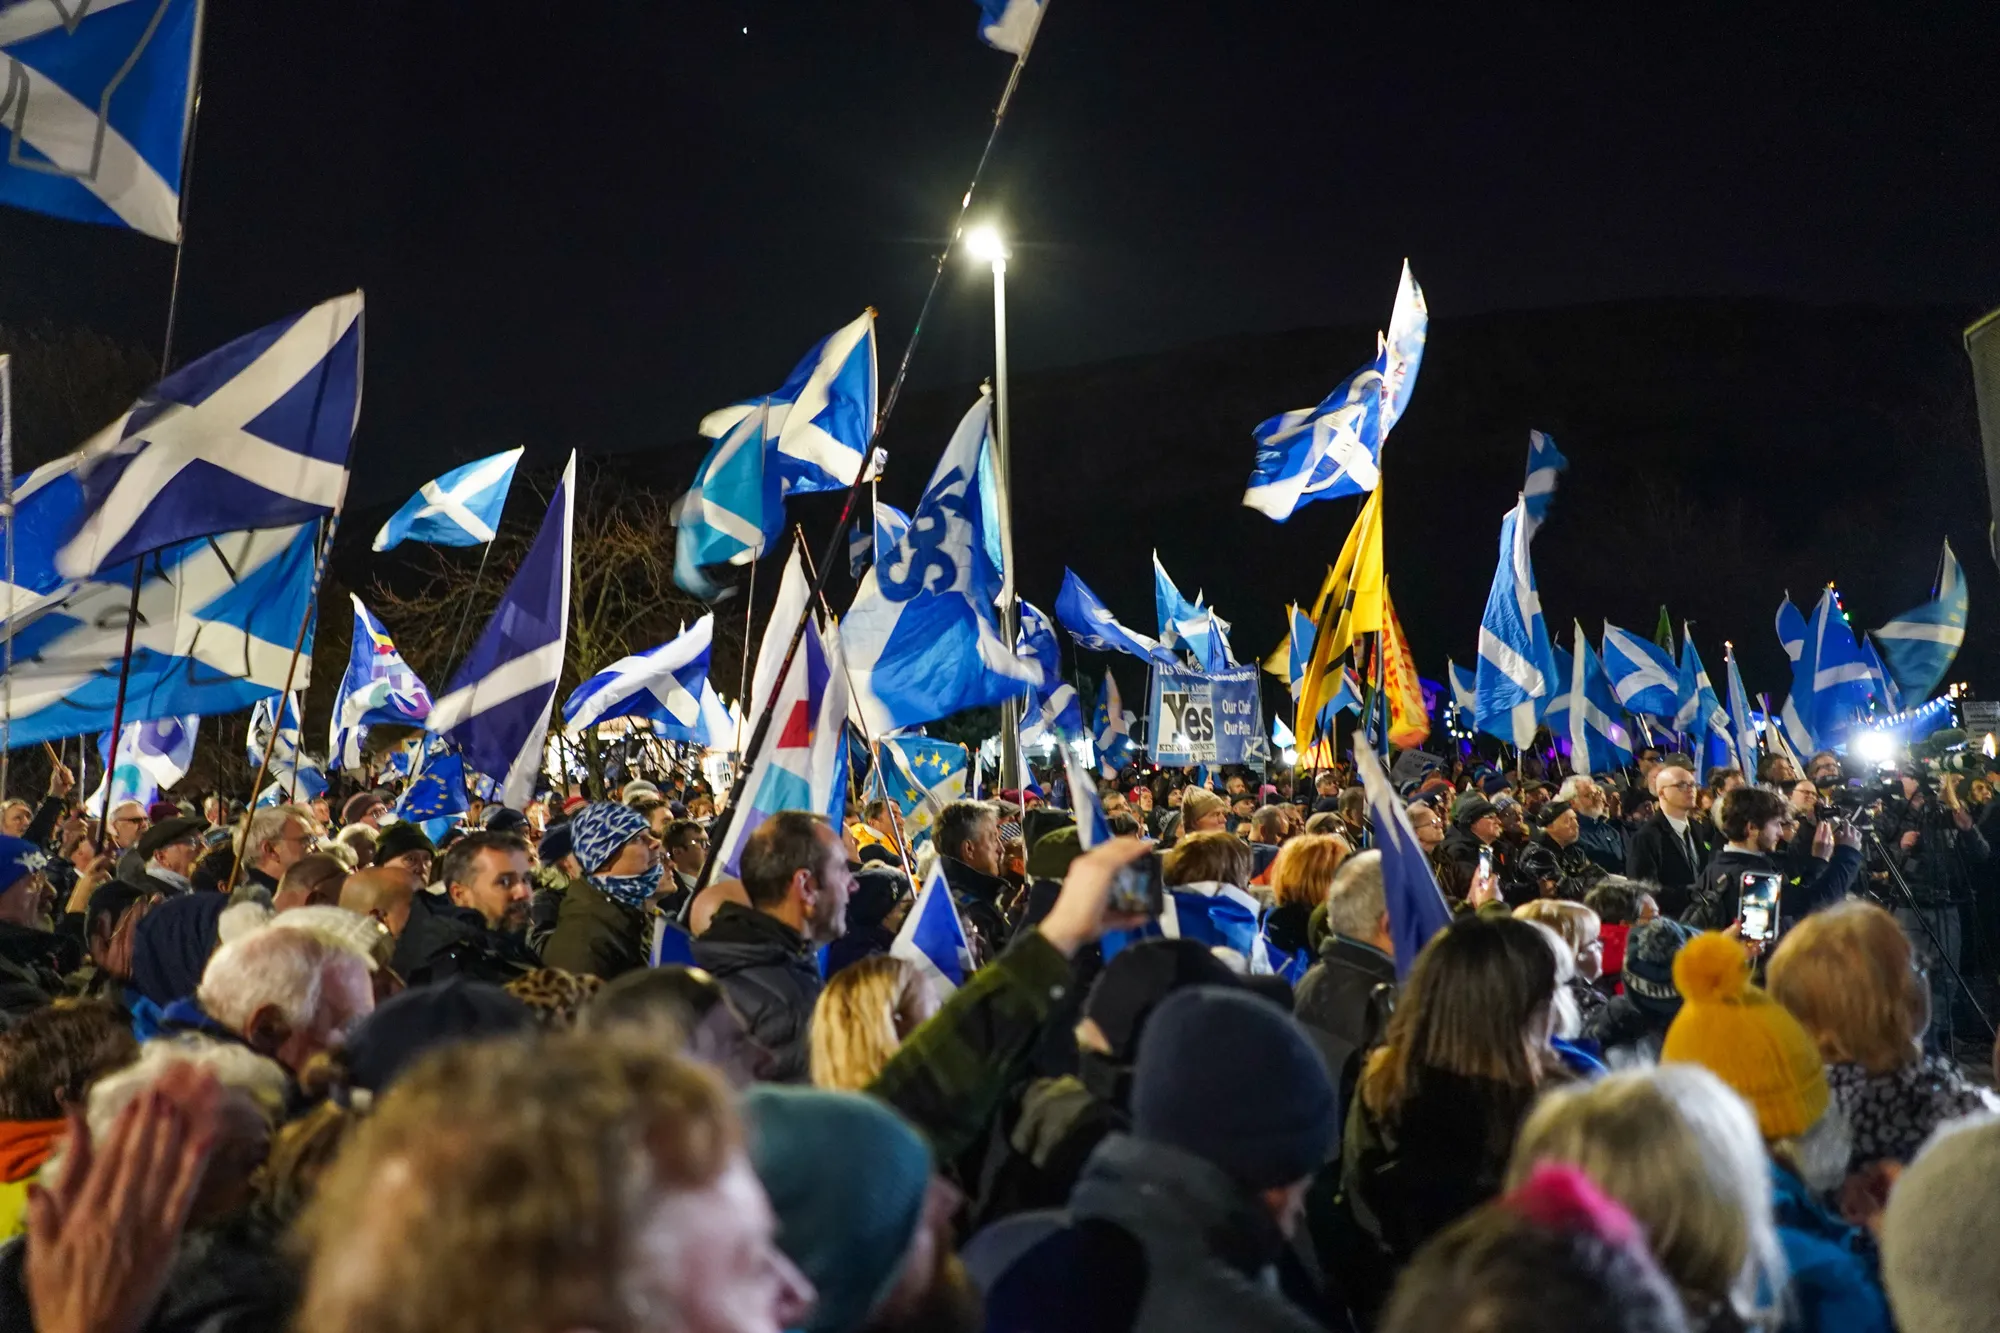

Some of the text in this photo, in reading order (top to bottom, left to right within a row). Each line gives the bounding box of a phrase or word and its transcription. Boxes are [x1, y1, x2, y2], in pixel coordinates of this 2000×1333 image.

[1222, 699, 1237, 714] Our
[1163, 693, 1214, 742] Yes
[1224, 720, 1238, 735] Our
